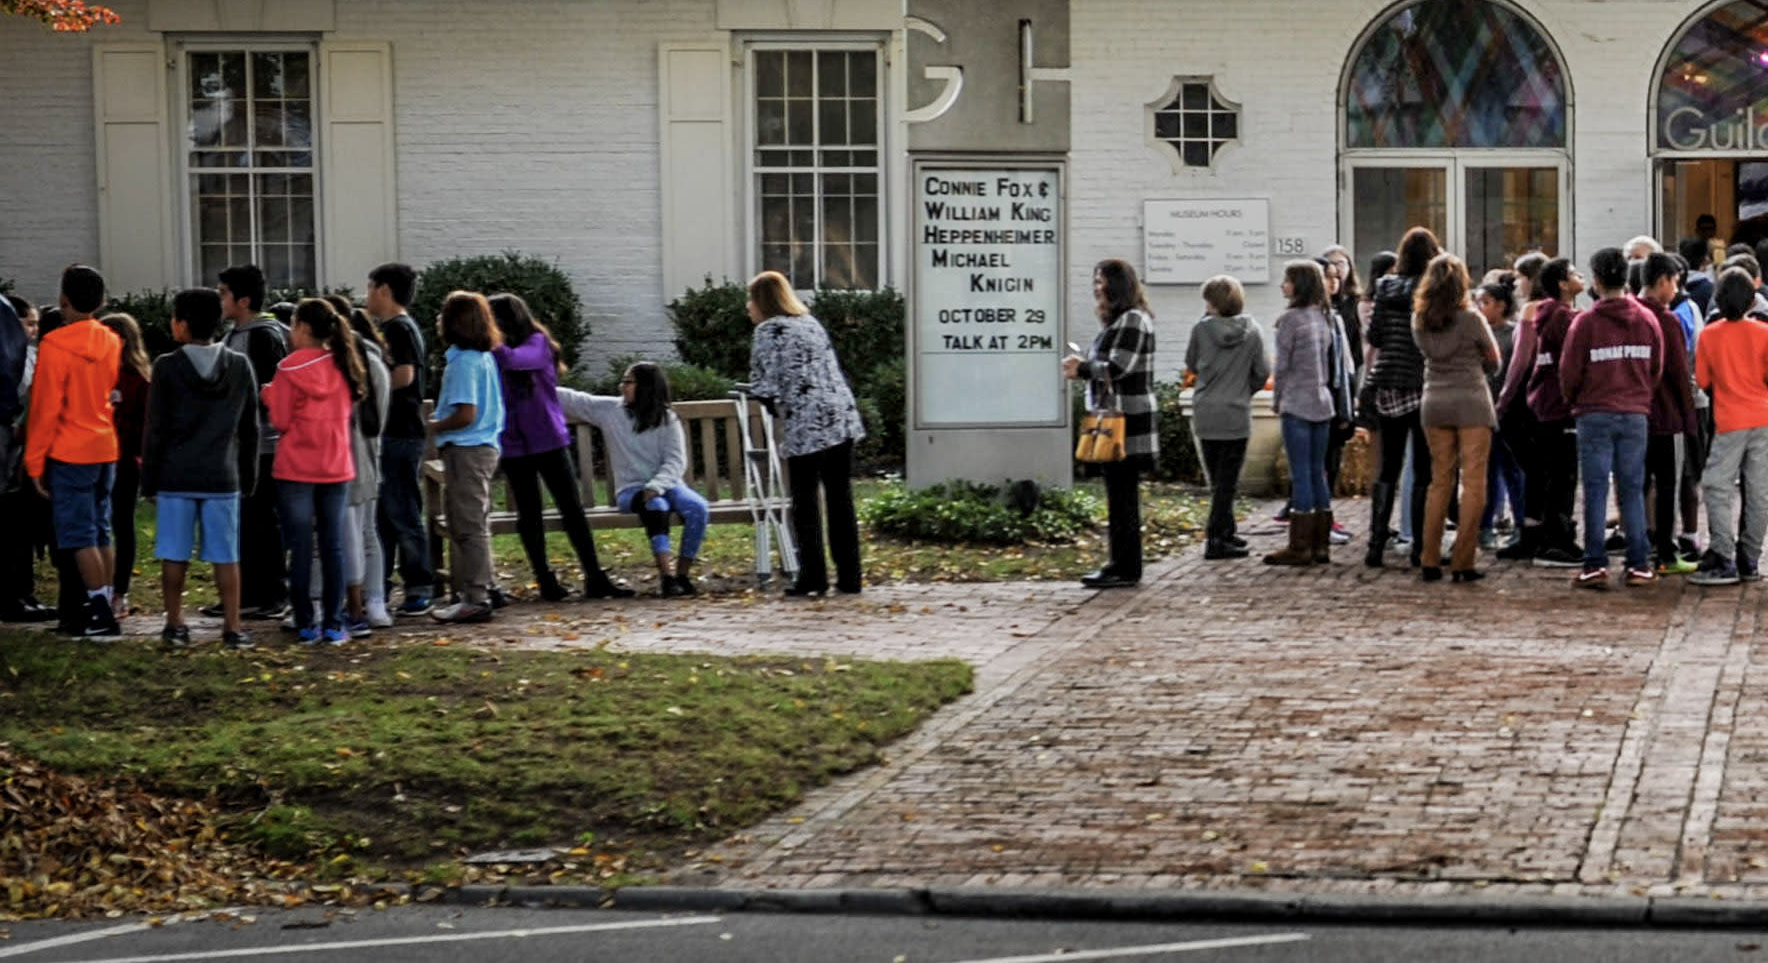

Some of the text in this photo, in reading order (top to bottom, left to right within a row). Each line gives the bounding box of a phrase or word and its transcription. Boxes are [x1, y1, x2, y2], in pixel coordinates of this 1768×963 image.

[924, 177, 986, 196] CONNIE
[924, 201, 1051, 222] WILLIAM KING
[924, 225, 1056, 244] HEPPENHEIMER
[1279, 238, 1304, 254] 158
[931, 249, 1011, 268] MICHAEL
[939, 308, 1046, 324] OCTOBER 29
[942, 335, 1053, 350] TALK AT 2PM
